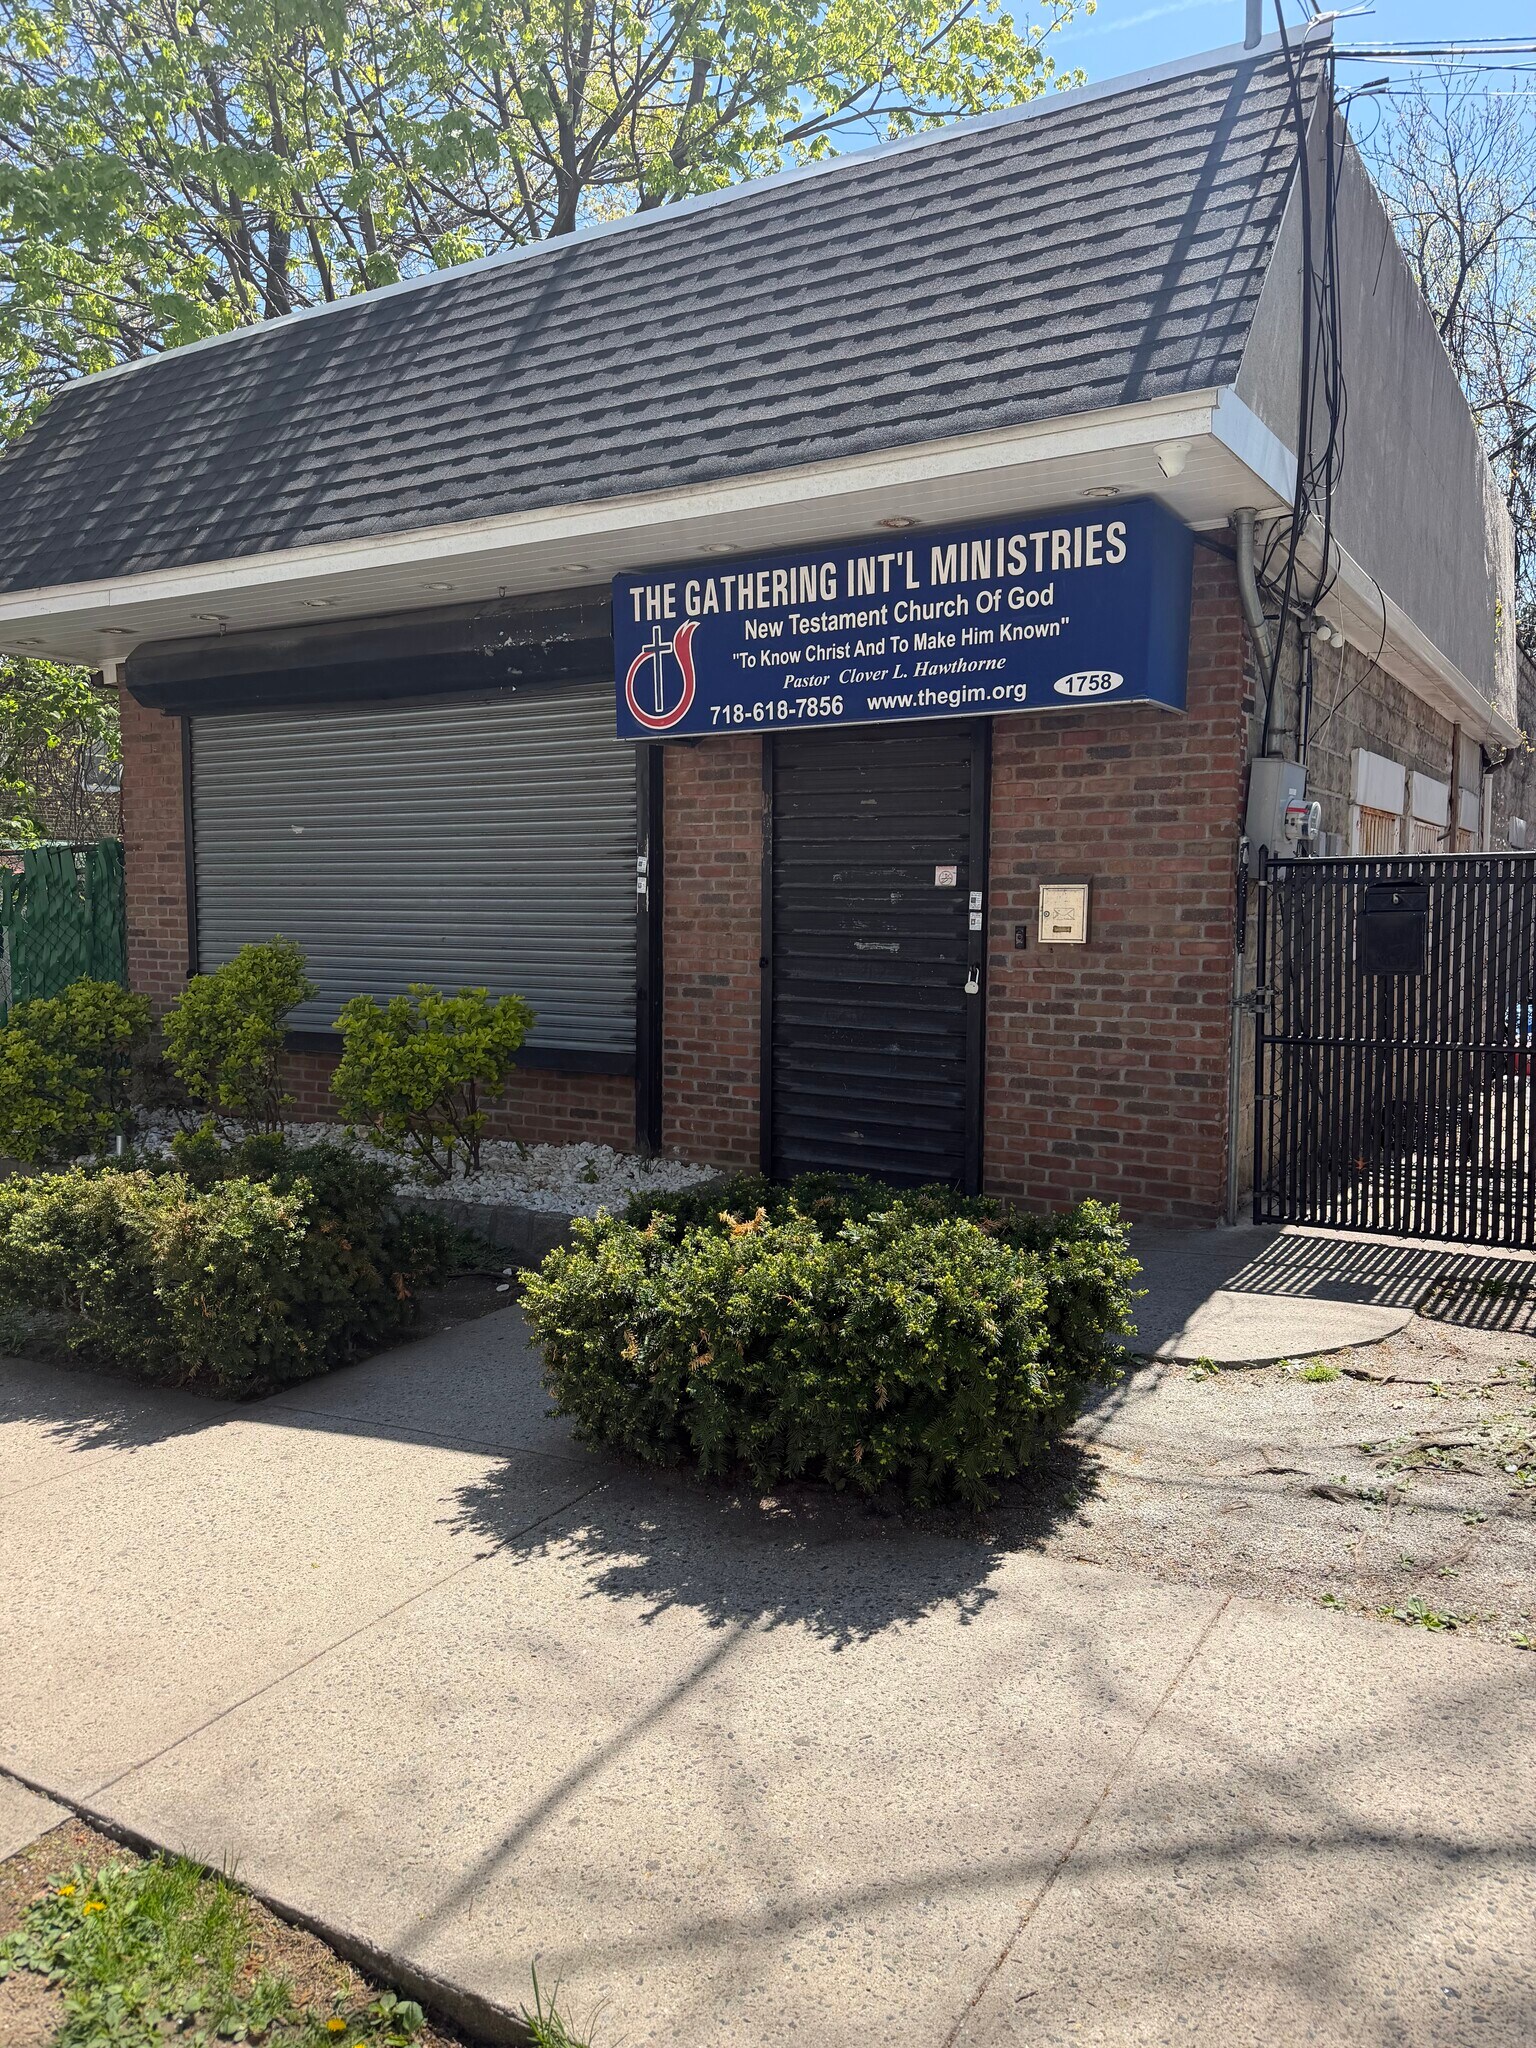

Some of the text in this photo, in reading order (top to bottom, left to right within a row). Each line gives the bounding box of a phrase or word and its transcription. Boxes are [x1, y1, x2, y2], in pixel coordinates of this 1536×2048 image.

[629, 521, 1127, 622] THE GATHERING INT'L MINISTRIES
[744, 582, 1054, 640] New Testament Church Of God
[732, 616, 1070, 669] "To Know Christ And To Make Him Known"
[783, 656, 1007, 690] Pastor Clover L. Hawthorne
[1064, 673, 1113, 694] 1758
[710, 682, 1027, 725] 718-618-7856 www.thegim.org
